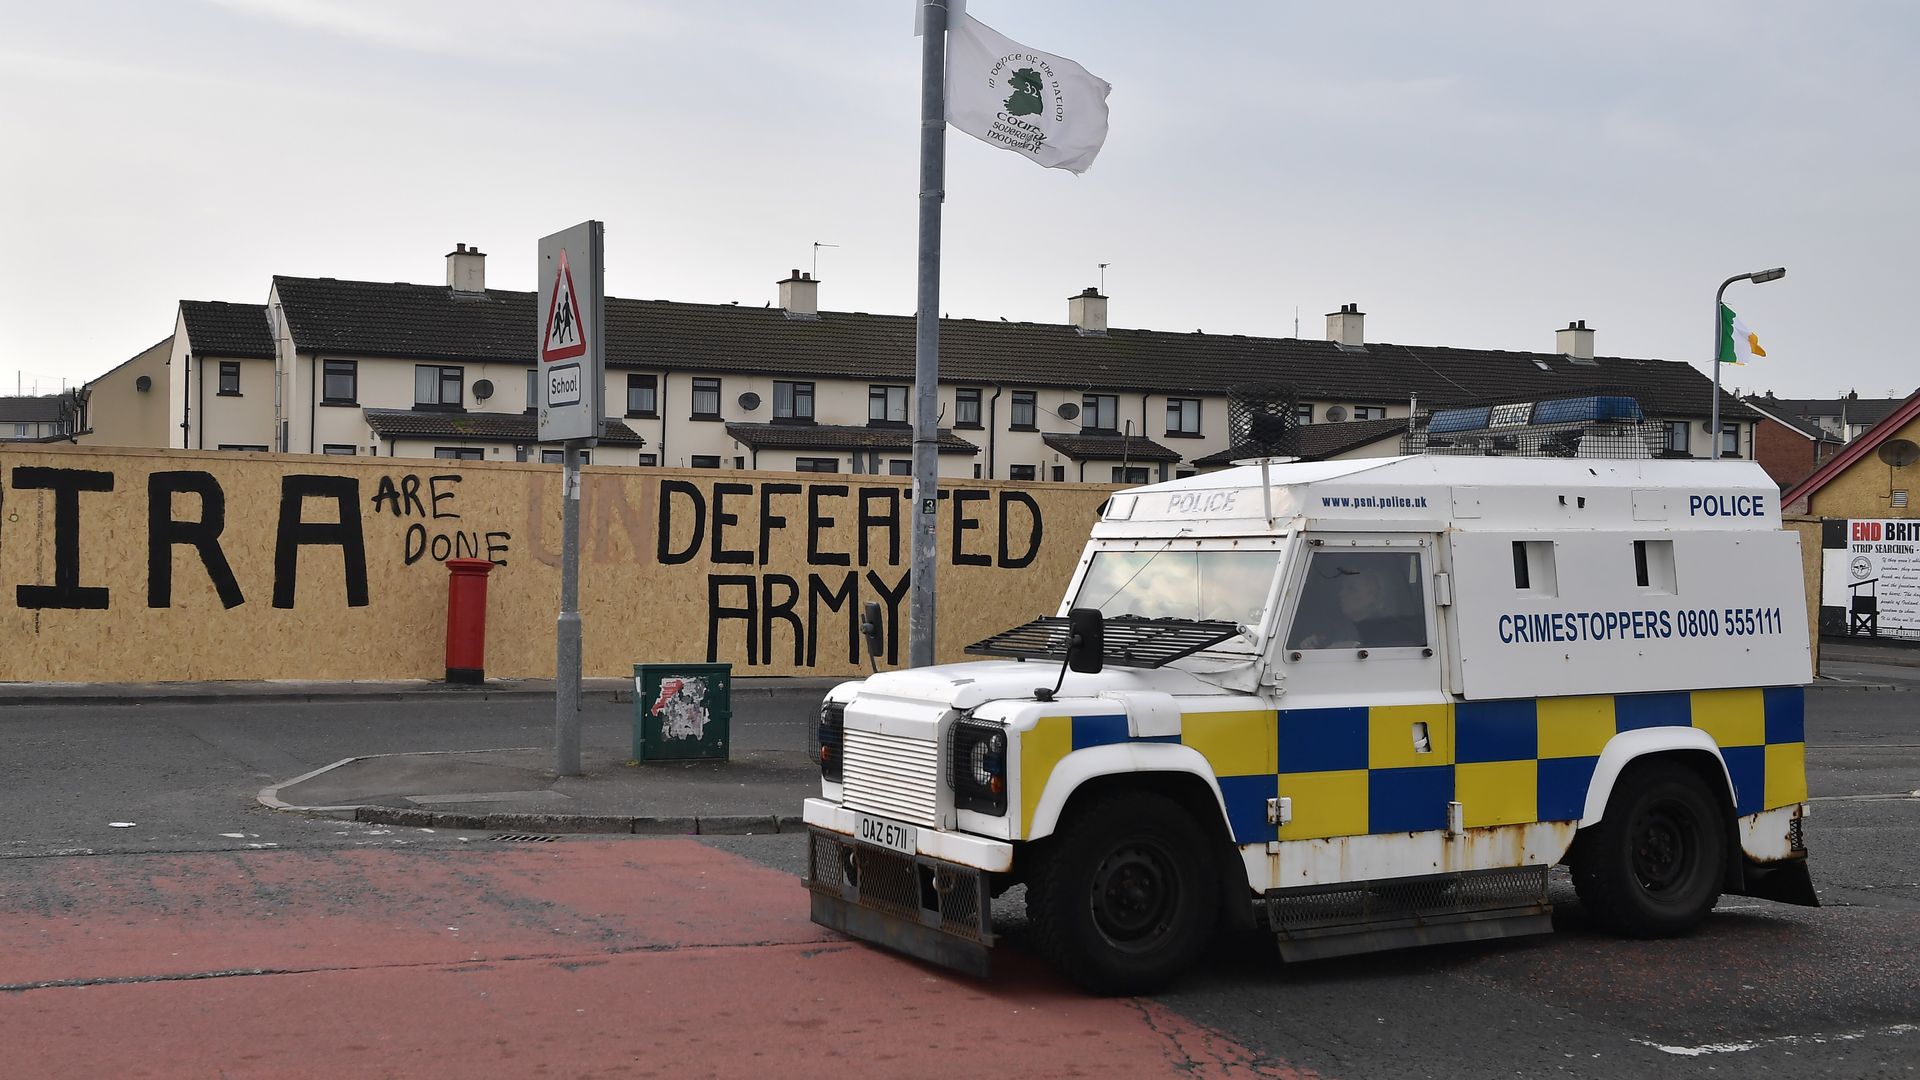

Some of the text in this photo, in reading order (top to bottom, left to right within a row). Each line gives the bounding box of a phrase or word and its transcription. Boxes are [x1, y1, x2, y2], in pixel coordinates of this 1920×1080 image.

[1025, 54, 1038, 65] of
[1039, 61, 1054, 78] the
[1023, 81, 1039, 98] 32
[551, 376, 578, 395] School
[371, 472, 463, 519] ARE
[1166, 490, 1239, 514] POLICE
[1321, 496, 1428, 509] www.psni.police.uk
[1689, 495, 1765, 517] POLICE
[11, 466, 370, 610] IRA
[1852, 522, 1882, 541] END
[404, 523, 512, 567] DONE
[1852, 544, 1914, 554] STRIP SEARCHING
[706, 567, 912, 667] ARMY
[1498, 607, 1782, 644] CRIMESTOPPERS 0800 555111
[862, 818, 907, 850] OAZ 6711
